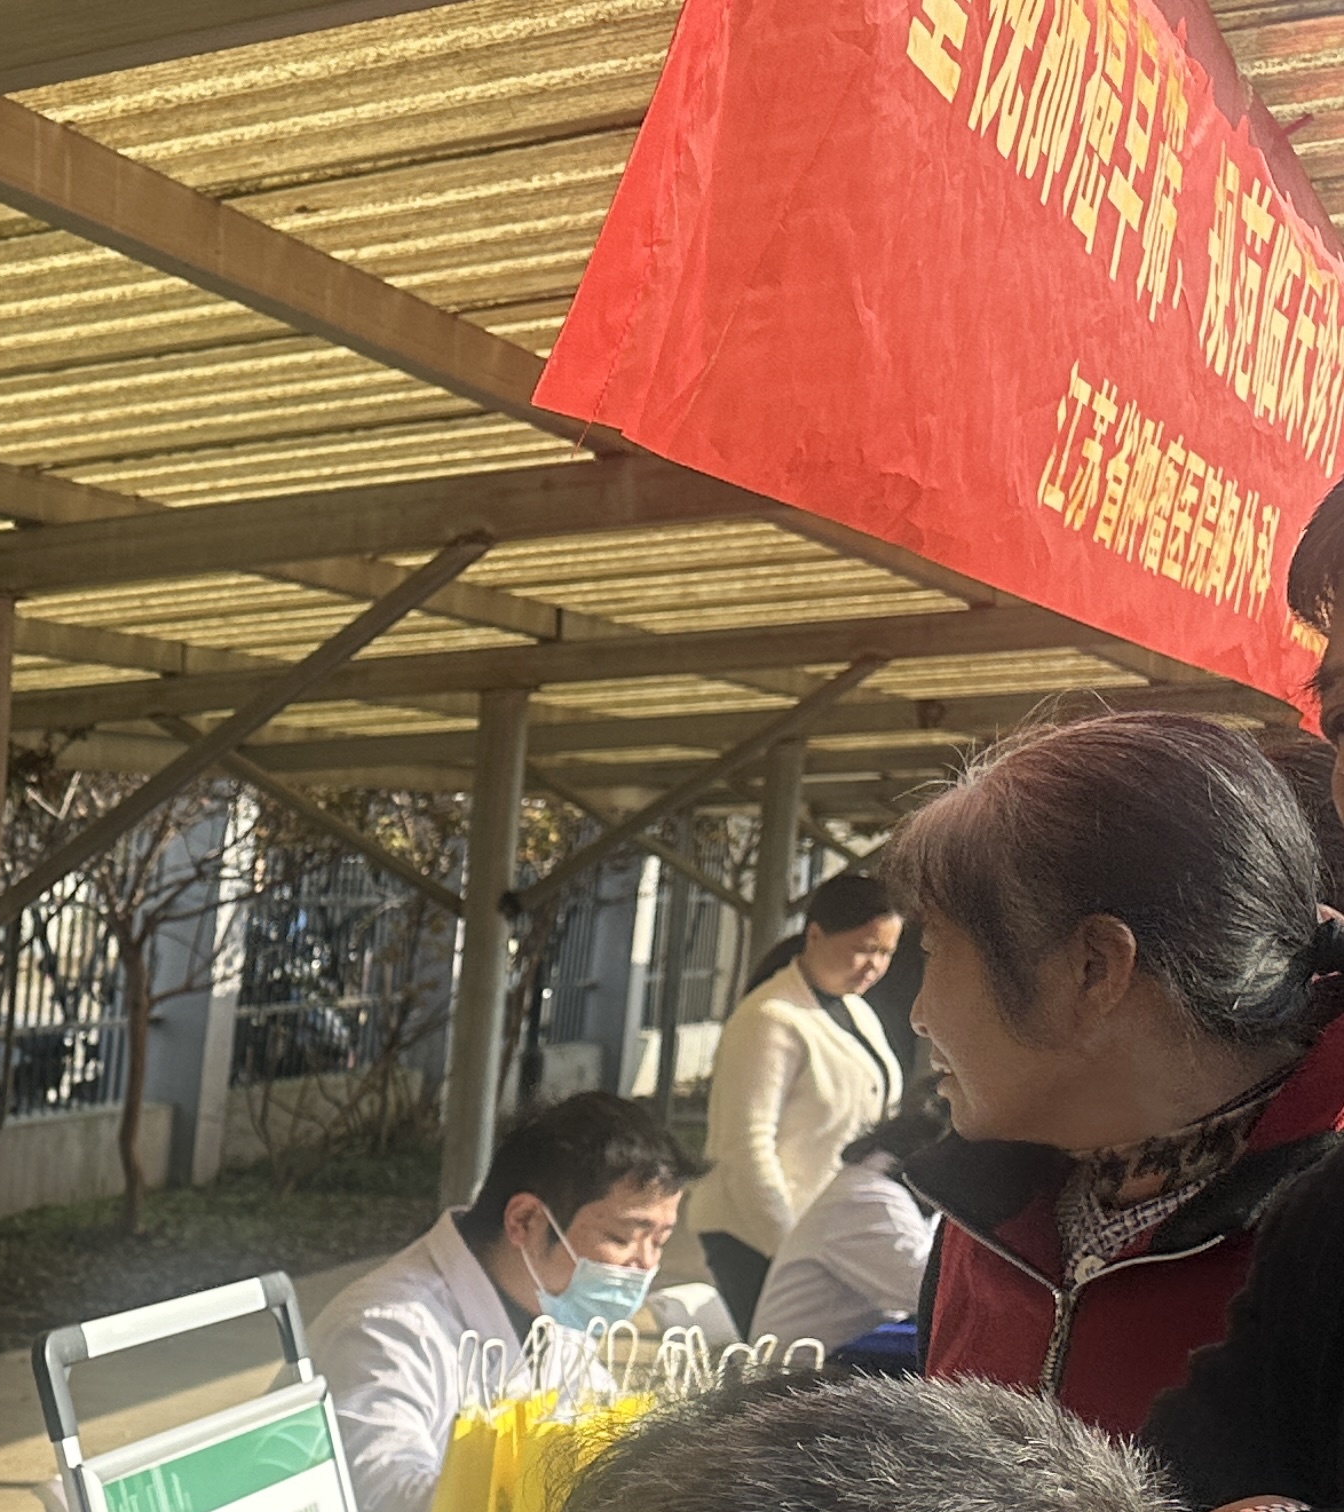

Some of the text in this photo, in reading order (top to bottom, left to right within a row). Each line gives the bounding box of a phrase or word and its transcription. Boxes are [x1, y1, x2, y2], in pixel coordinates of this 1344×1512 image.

[1037, 358, 1281, 623] 江苏省肿瘤医院胸外科
